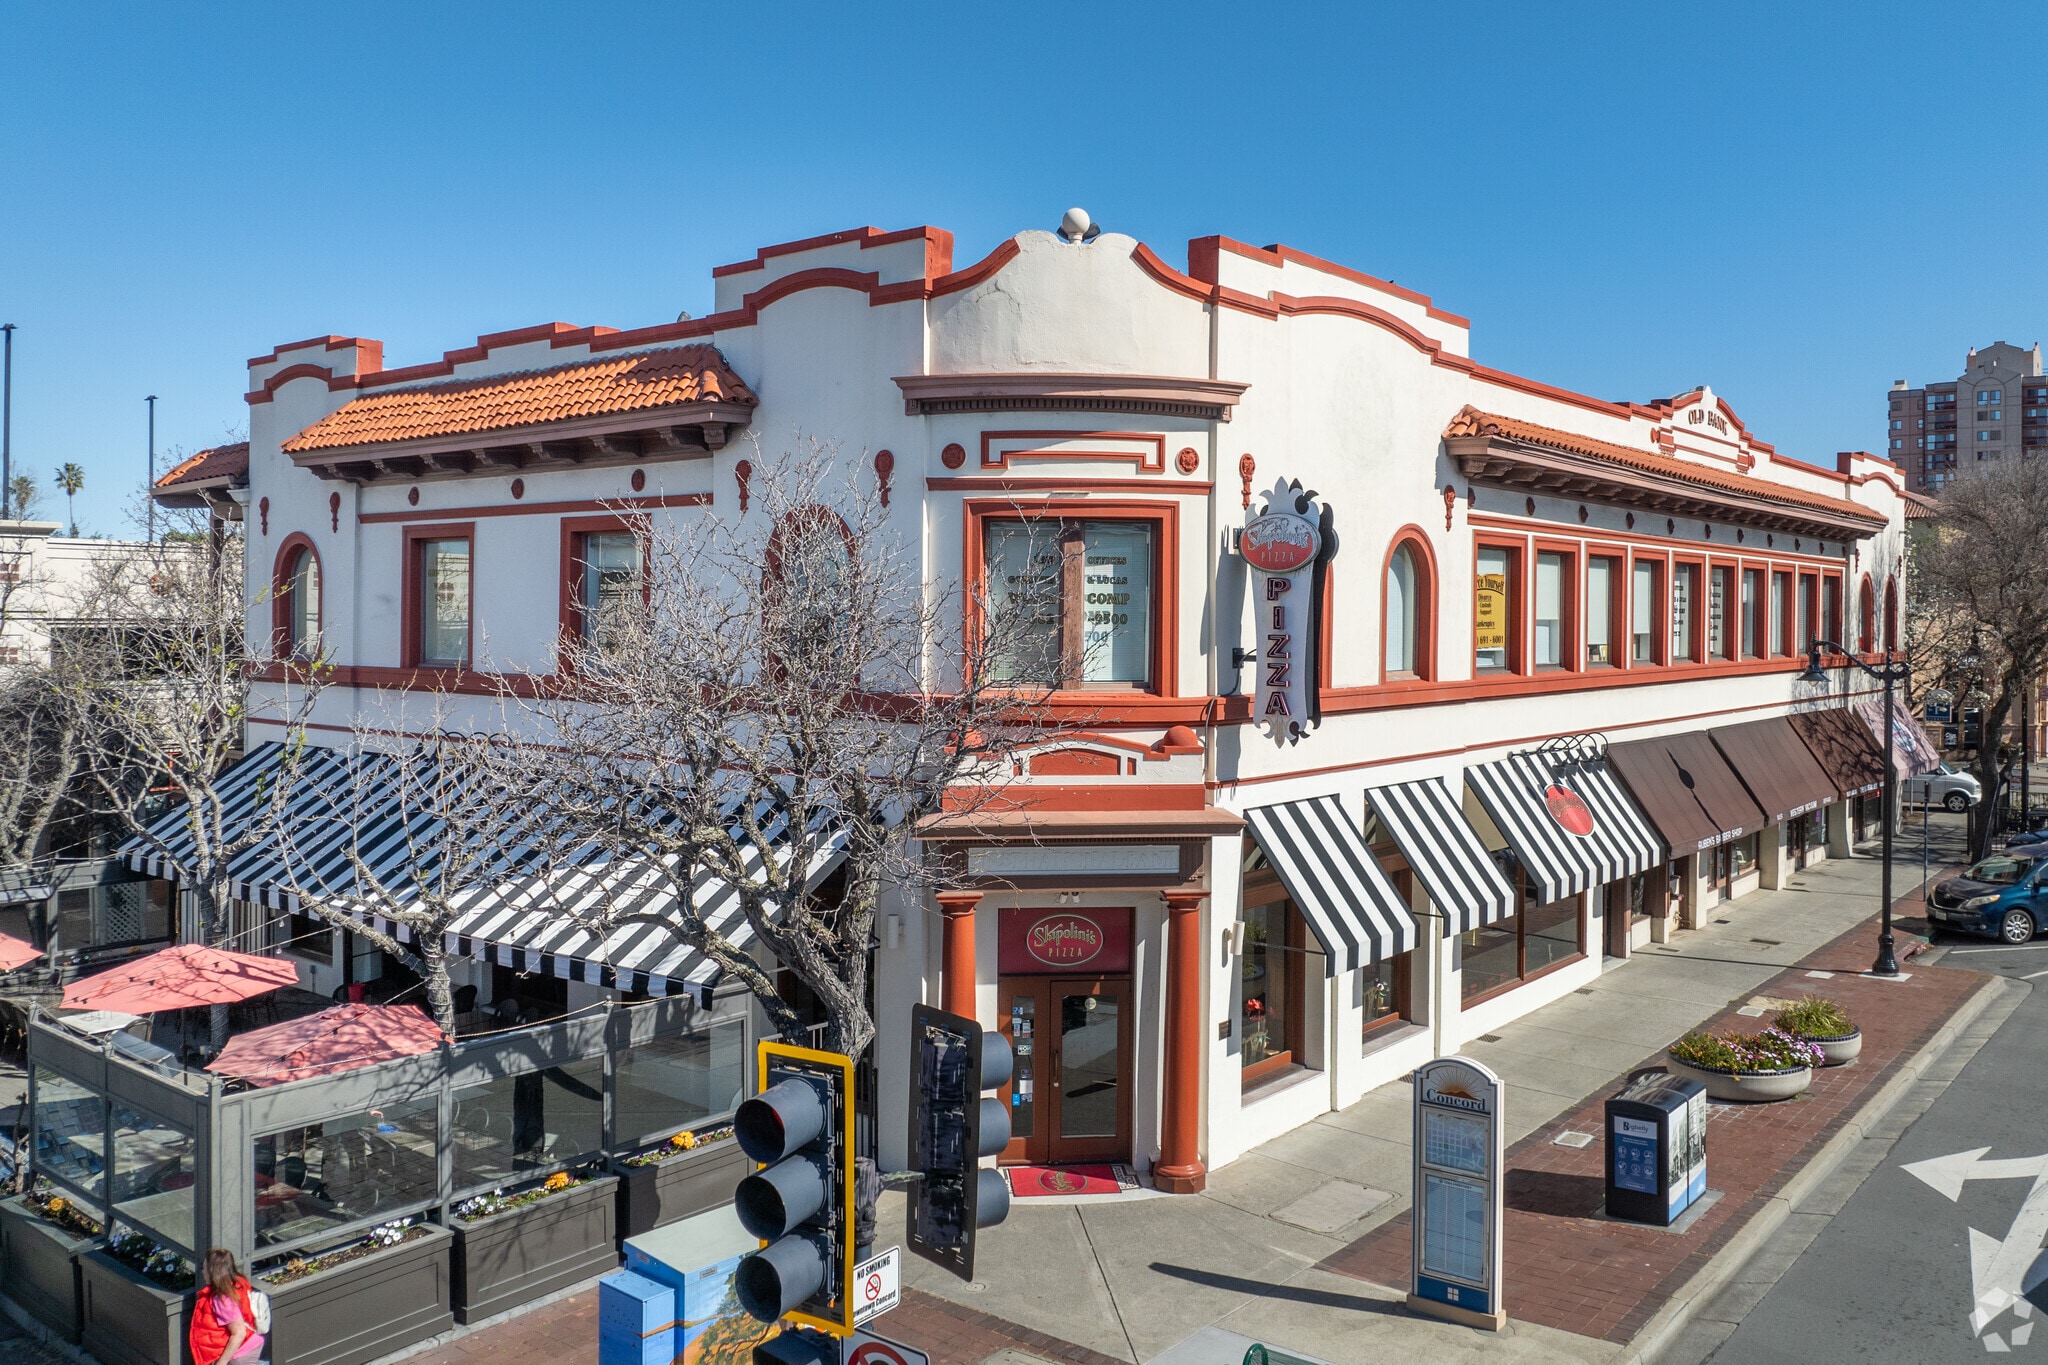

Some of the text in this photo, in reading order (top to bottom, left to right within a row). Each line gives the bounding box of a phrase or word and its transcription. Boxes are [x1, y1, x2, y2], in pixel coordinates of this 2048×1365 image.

[1688, 409, 1728, 436] OLD BANK
[1087, 556, 1127, 565] OFFICES
[1261, 551, 1294, 562] PIZZA
[1098, 576, 1128, 585] LUCAS
[1087, 593, 1131, 605] COMP
[1265, 577, 1291, 716] PIZZA
[1715, 830, 1731, 844] BABER
[1731, 827, 1743, 838] SHOP
[1034, 921, 1096, 947] Skipolini's
[1048, 947, 1083, 957] PIZZA
[1426, 1087, 1486, 1112] Concord
[857, 1255, 891, 1280] NO SMOKING
[876, 1289, 896, 1305] Concord
